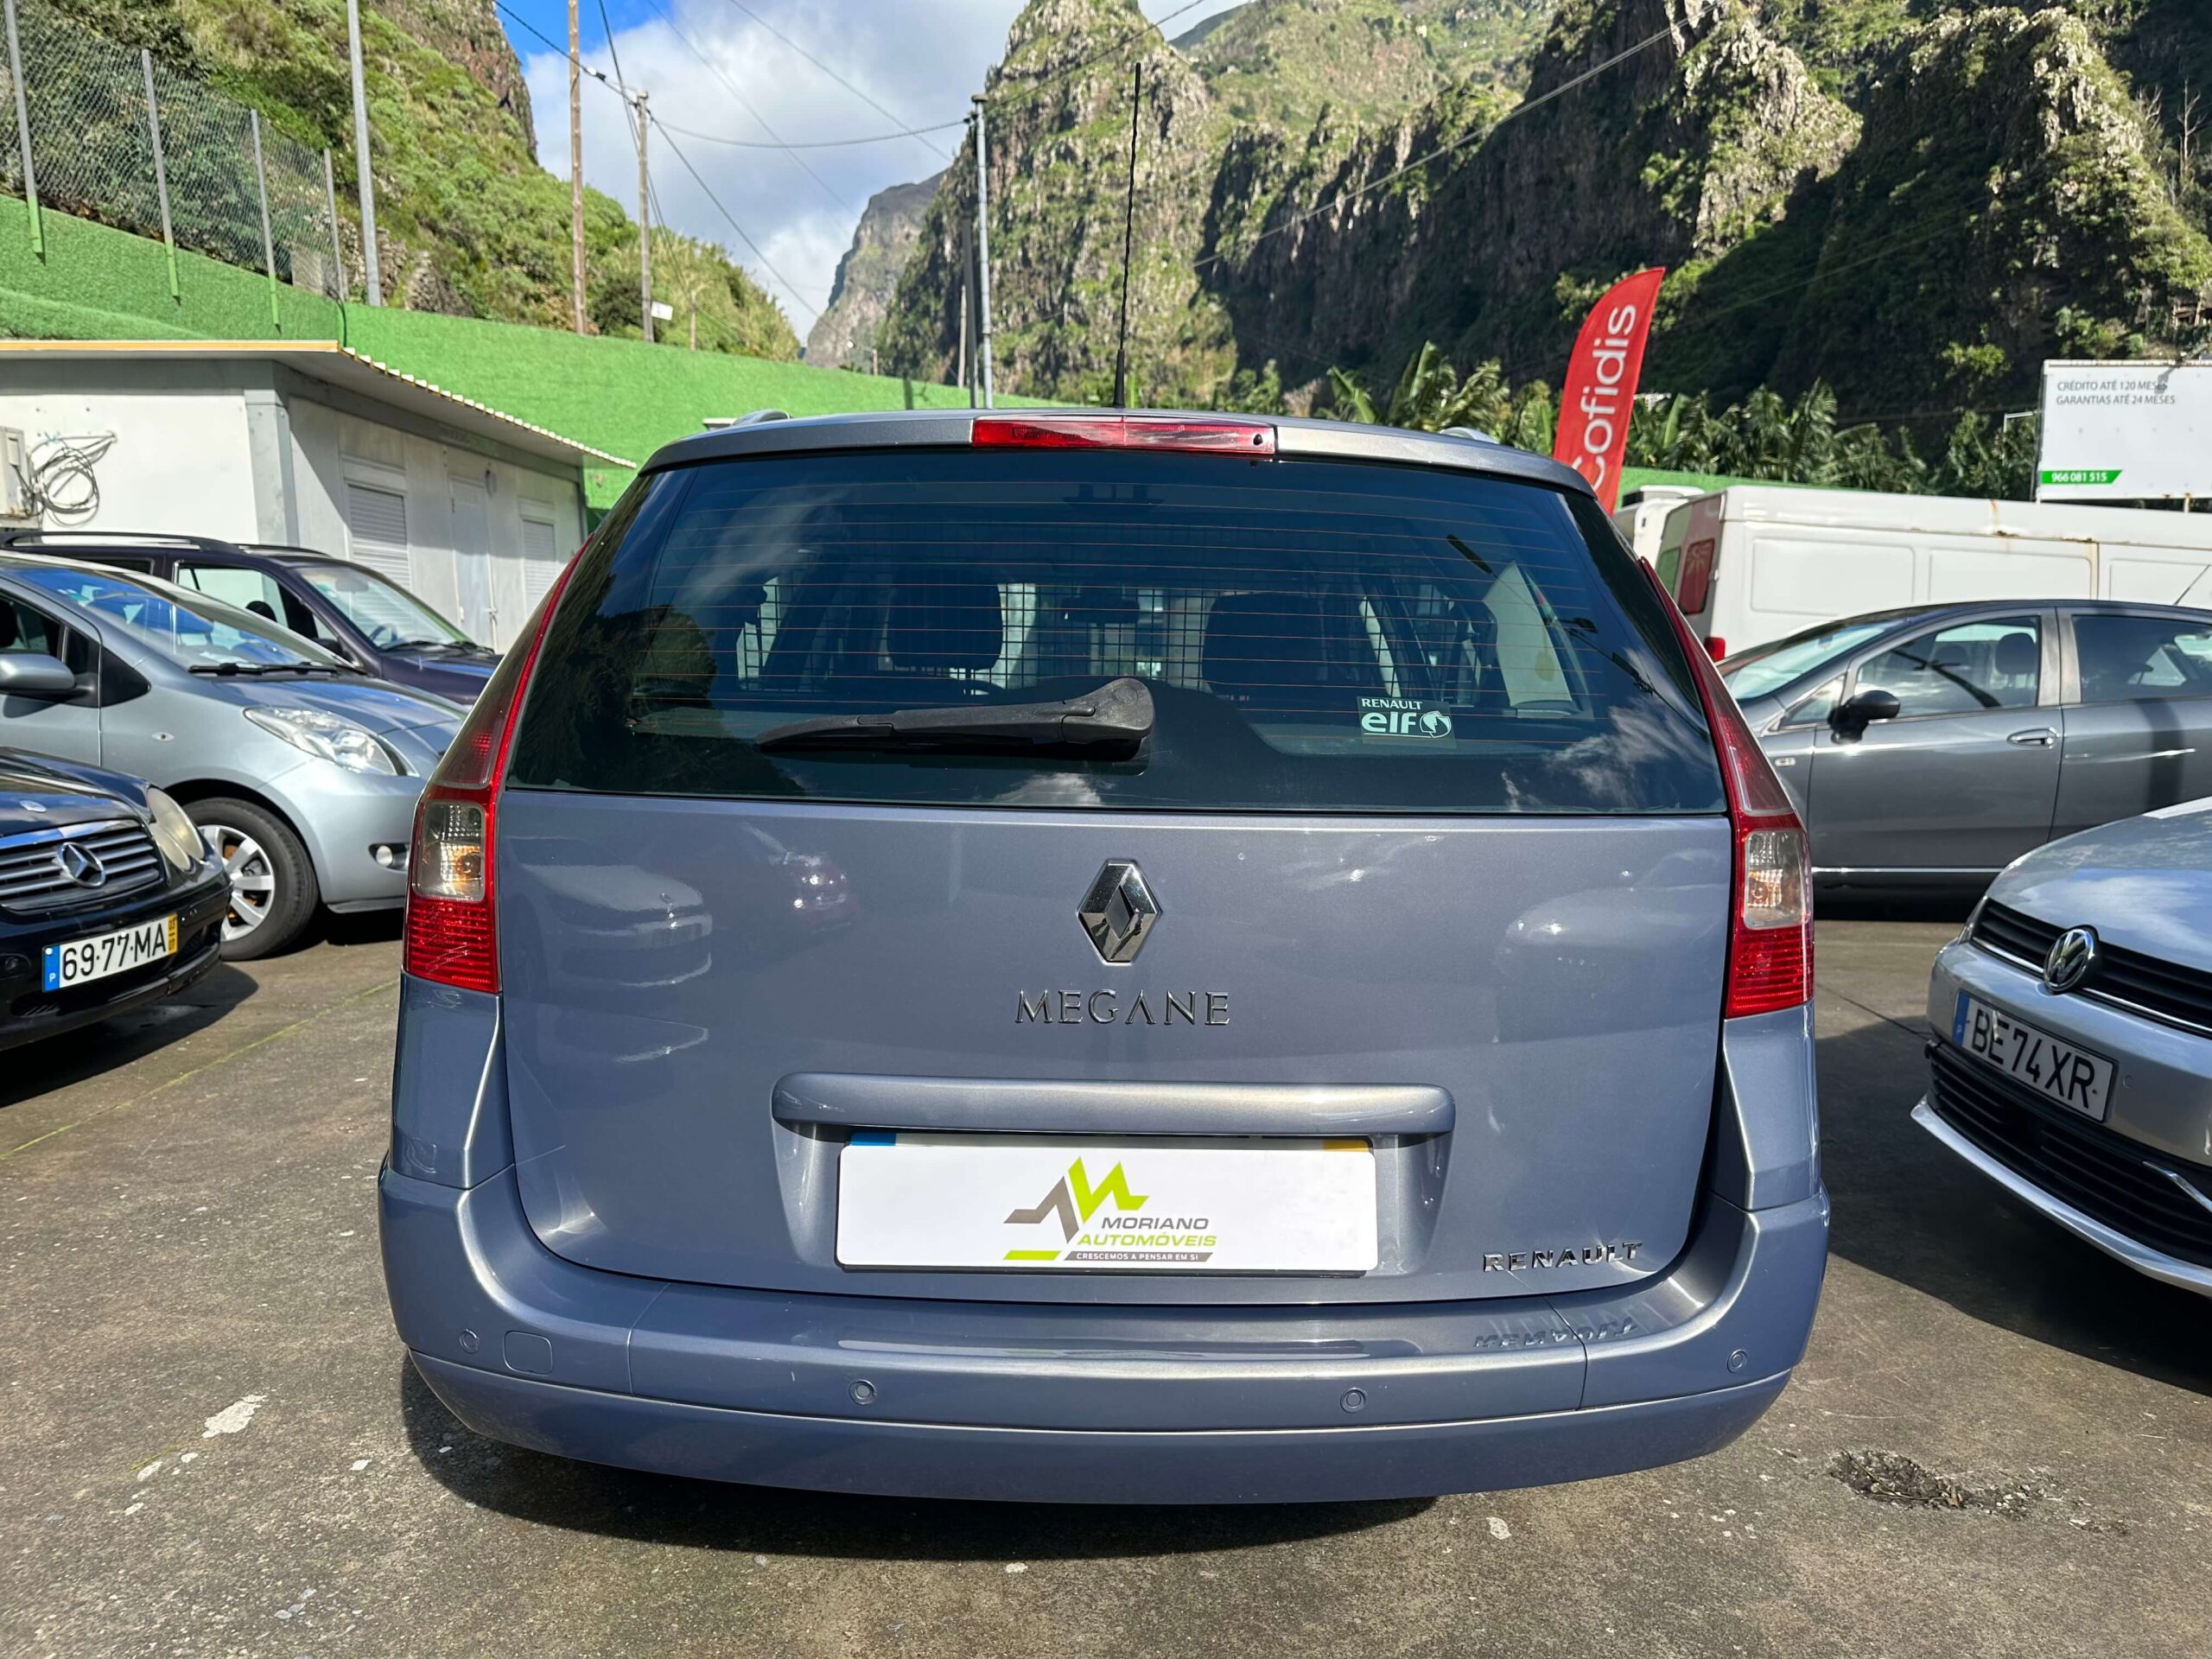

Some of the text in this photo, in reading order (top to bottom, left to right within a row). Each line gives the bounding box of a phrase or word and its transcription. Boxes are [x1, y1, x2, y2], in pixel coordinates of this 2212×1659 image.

[2057, 380, 2098, 391] CRÉDITO
[2100, 379, 2117, 391] ATÉ
[2120, 381, 2136, 391] 120
[2056, 394, 2176, 405] GARANTIAS ATÉ 24 MESES
[2051, 472, 2107, 483] 966 081 515
[1361, 698, 1423, 710] RENAULT
[1361, 711, 1417, 734] elf
[49, 973, 56, 982] P
[1015, 988, 1230, 1026] MEGANE
[1102, 1217, 1210, 1230] MORIANO
[1077, 1232, 1217, 1247] AUTOMÓVEIS
[1484, 1242, 1643, 1273] RENAULT
